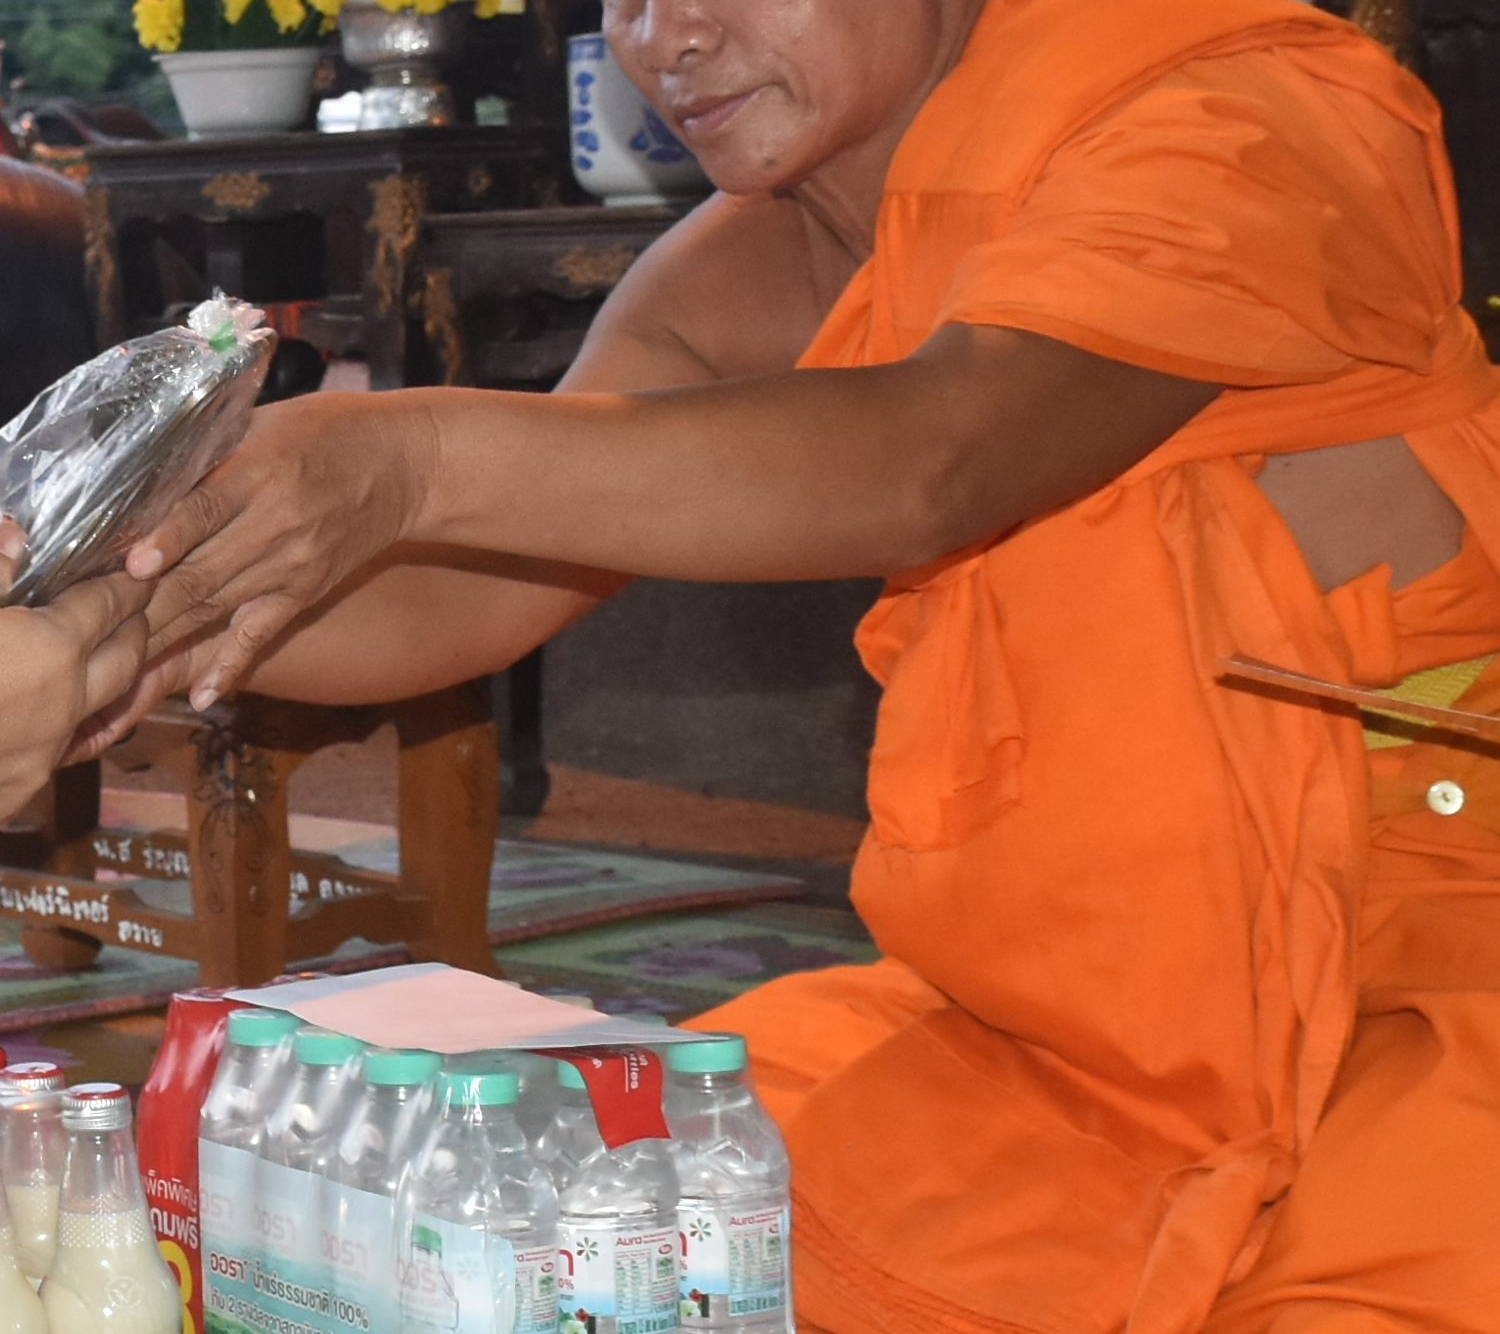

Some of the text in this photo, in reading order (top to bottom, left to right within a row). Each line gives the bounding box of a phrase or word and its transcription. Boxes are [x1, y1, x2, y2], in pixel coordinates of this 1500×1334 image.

[144, 1169, 198, 1213] พ็คพิเศษ
[150, 1207, 198, 1251] ถมฟรี
[209, 1252, 370, 1331] ออรา น้ำแร่ธรรมชาติ 100%
